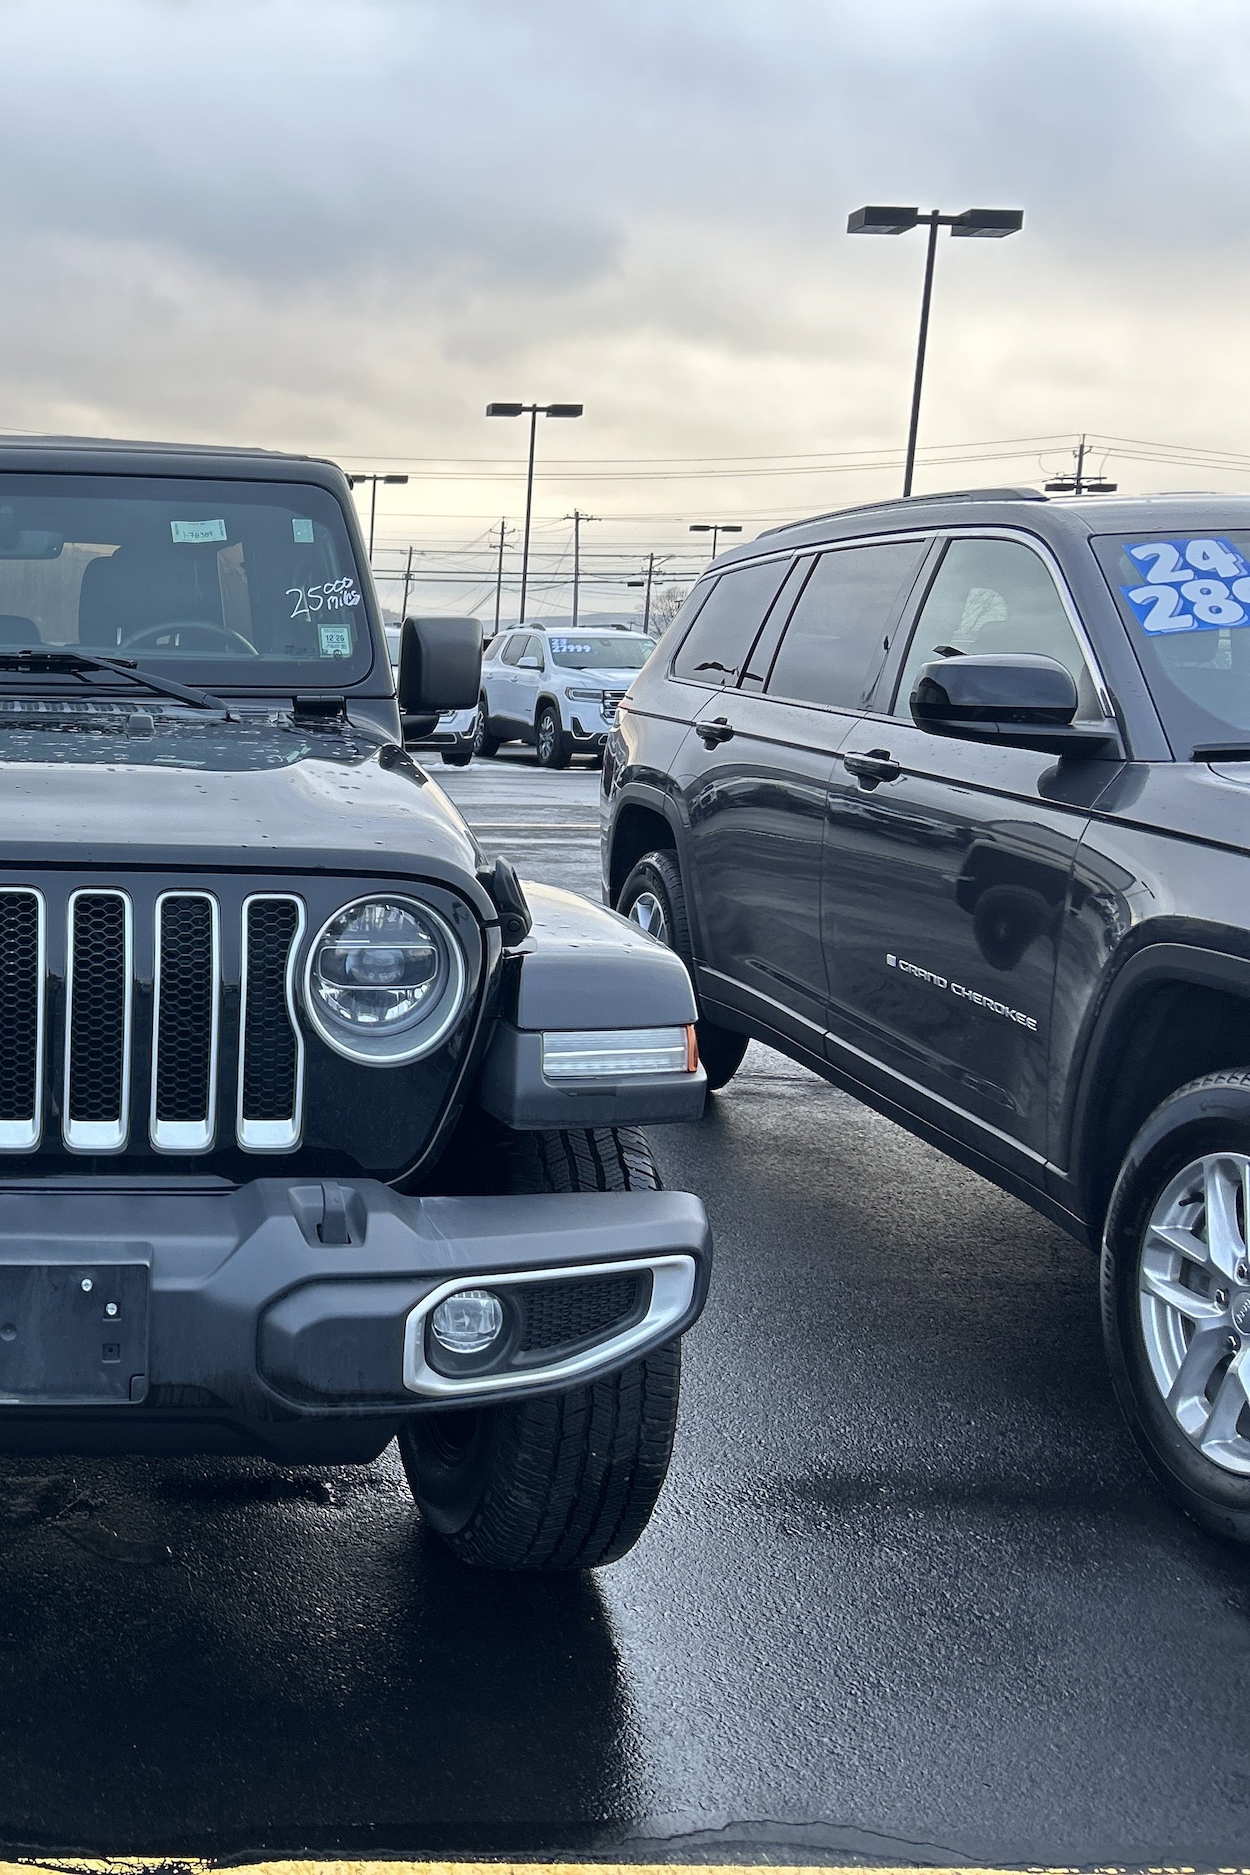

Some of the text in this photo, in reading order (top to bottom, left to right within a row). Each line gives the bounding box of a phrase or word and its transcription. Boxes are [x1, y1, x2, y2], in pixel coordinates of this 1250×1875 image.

[1130, 539, 1248, 584] 24
[898, 959, 1038, 1032] GRAND CHEROKEE
